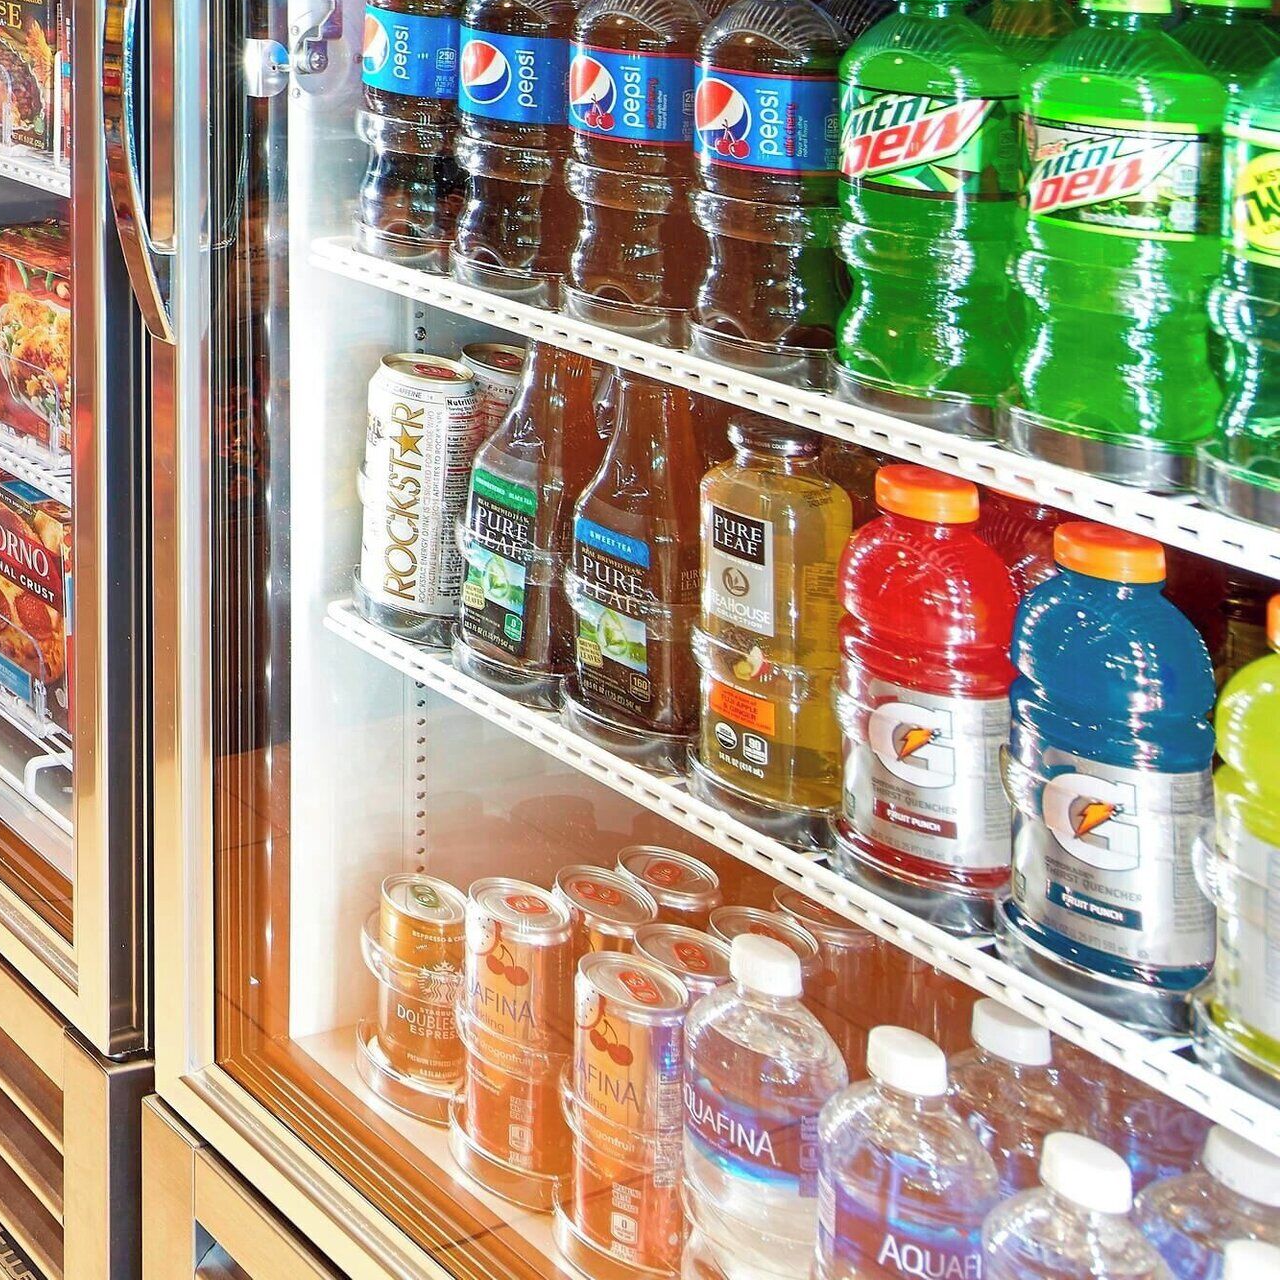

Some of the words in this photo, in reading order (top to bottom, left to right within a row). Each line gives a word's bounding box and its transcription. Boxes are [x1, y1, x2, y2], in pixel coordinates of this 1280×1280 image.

[392, 24, 409, 80] pepsi
[517, 49, 535, 109] pepsi
[623, 65, 642, 129] pepsi
[759, 88, 780, 157] pepsi
[474, 508, 529, 543] PURE
[588, 530, 619, 548] SWEET
[619, 542, 633, 554] TEA
[714, 512, 762, 542] PURE
[714, 534, 759, 556] LEAF
[20, 577, 55, 604] CRUST
[582, 558, 644, 593] PURE
[1061, 891, 1093, 913] FRUIT
[1092, 903, 1124, 923] PUNCH
[877, 1233, 982, 1280] AQUAFI
